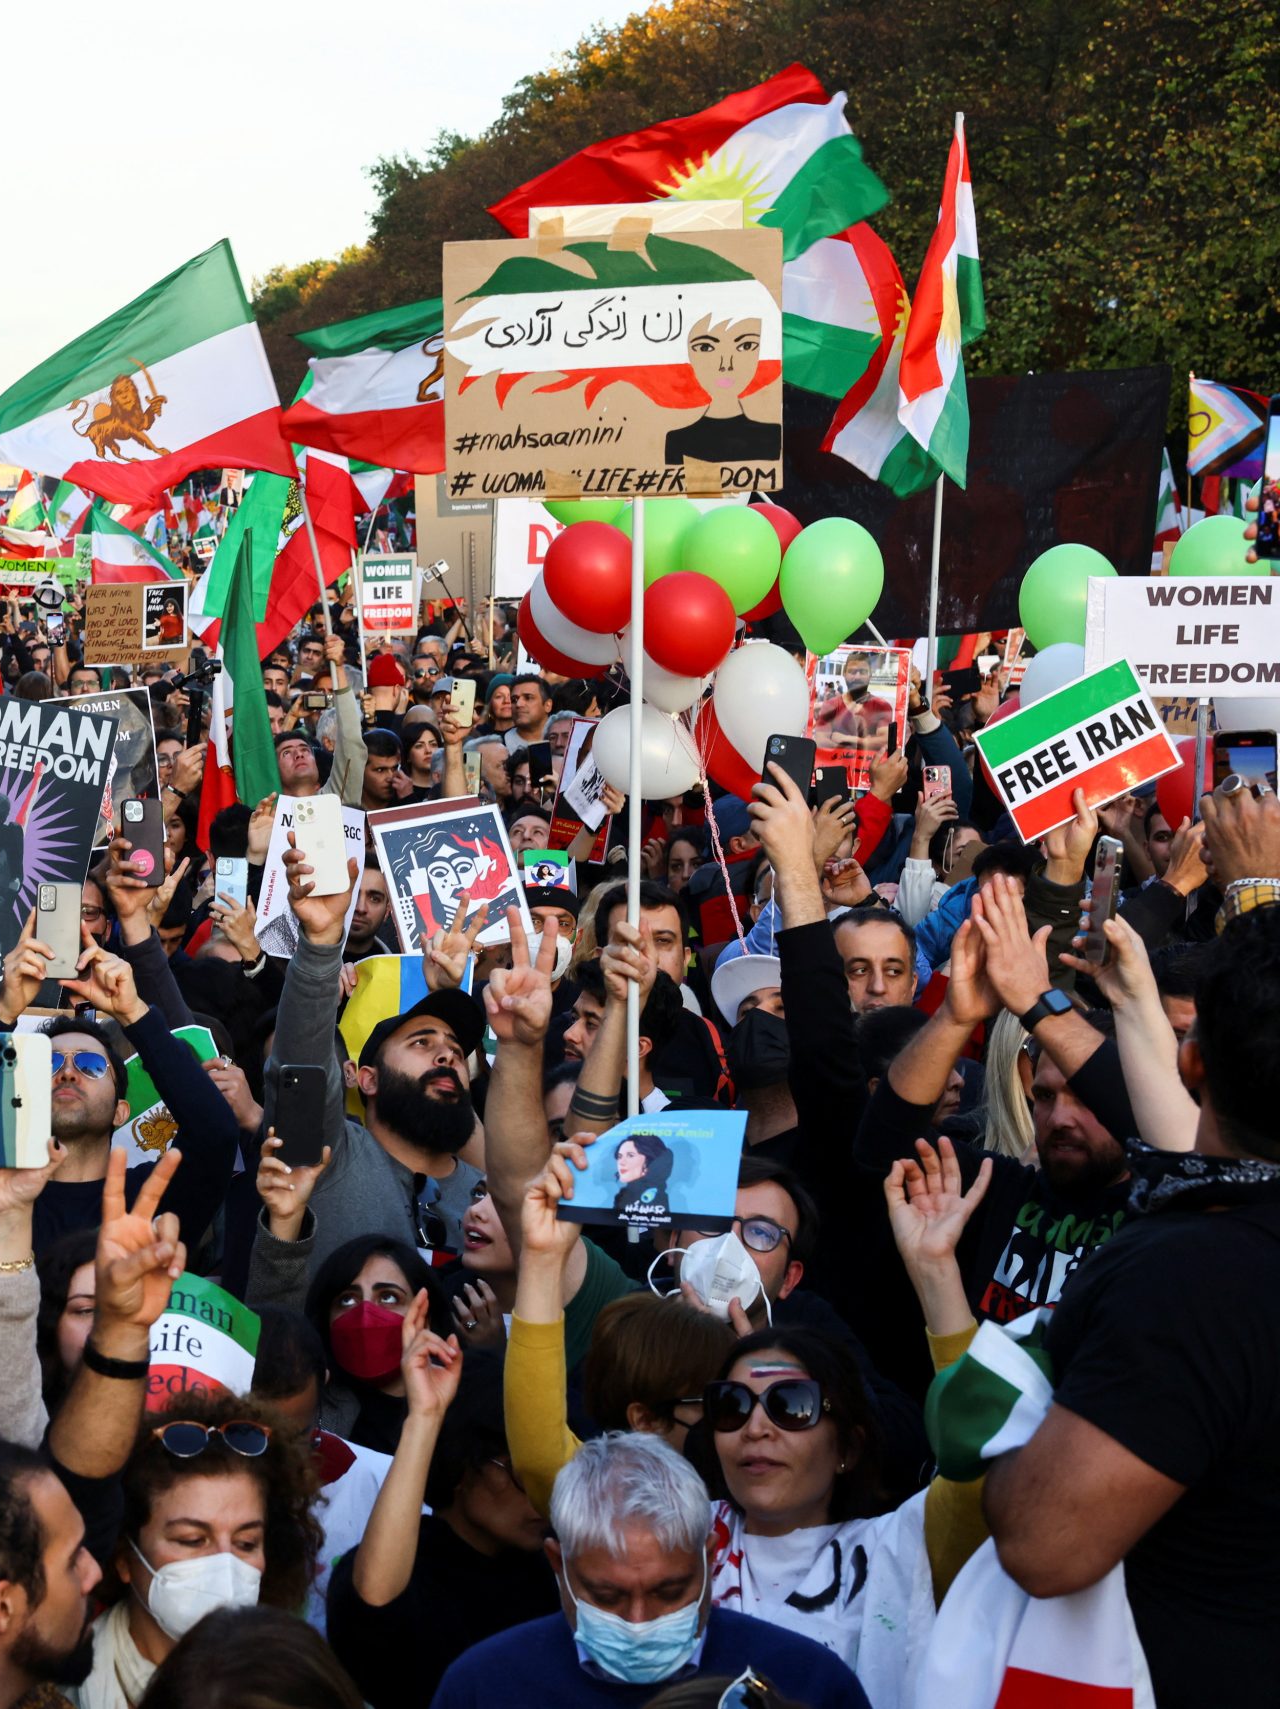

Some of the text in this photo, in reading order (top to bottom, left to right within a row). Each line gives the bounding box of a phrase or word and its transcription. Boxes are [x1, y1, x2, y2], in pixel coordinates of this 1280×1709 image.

[485, 293, 683, 348] زن زندگی آزادی
[453, 416, 628, 455] #mahsaamini
[482, 470, 546, 493] WOMA
[365, 565, 410, 577] WOMEN
[89, 590, 107, 598] HER
[148, 589, 165, 597] TAKE
[373, 586, 403, 600] LIFE
[1146, 585, 1273, 607] WOMEN
[87, 606, 106, 616] WAS
[147, 604, 164, 612] HAND
[364, 607, 412, 618] FREEDOM
[118, 619, 139, 627] LOVED
[87, 630, 102, 638] RED
[1176, 624, 1240, 645] LIFE
[997, 739, 1078, 804] FREE
[1075, 700, 1157, 762] IRAN
[343, 825, 362, 841] RGC
[263, 869, 278, 917] #MahsaAmini
[167, 1290, 234, 1335] man
